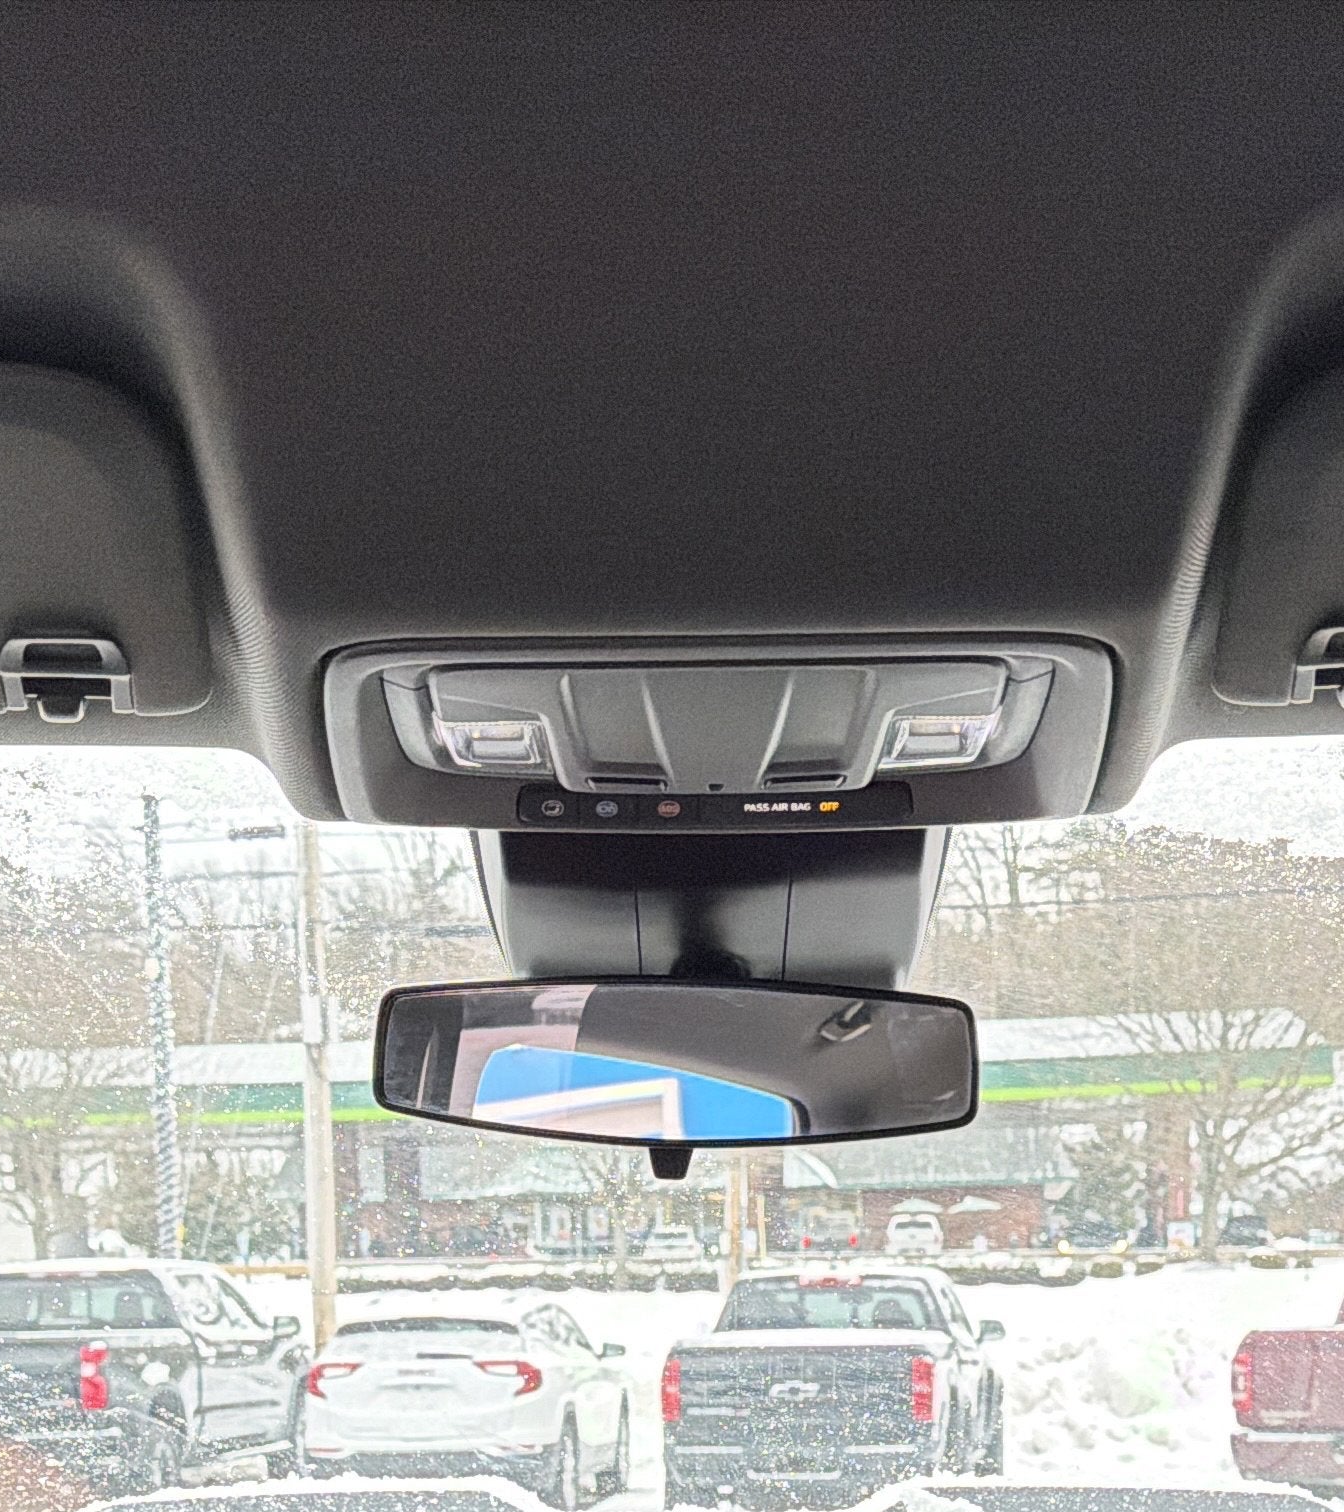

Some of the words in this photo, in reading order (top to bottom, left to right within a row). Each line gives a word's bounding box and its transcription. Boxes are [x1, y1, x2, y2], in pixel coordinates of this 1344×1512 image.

[744, 804, 769, 812] PASS
[771, 803, 789, 812] AIR
[790, 803, 811, 812] BAG
[819, 802, 840, 812] OFF
